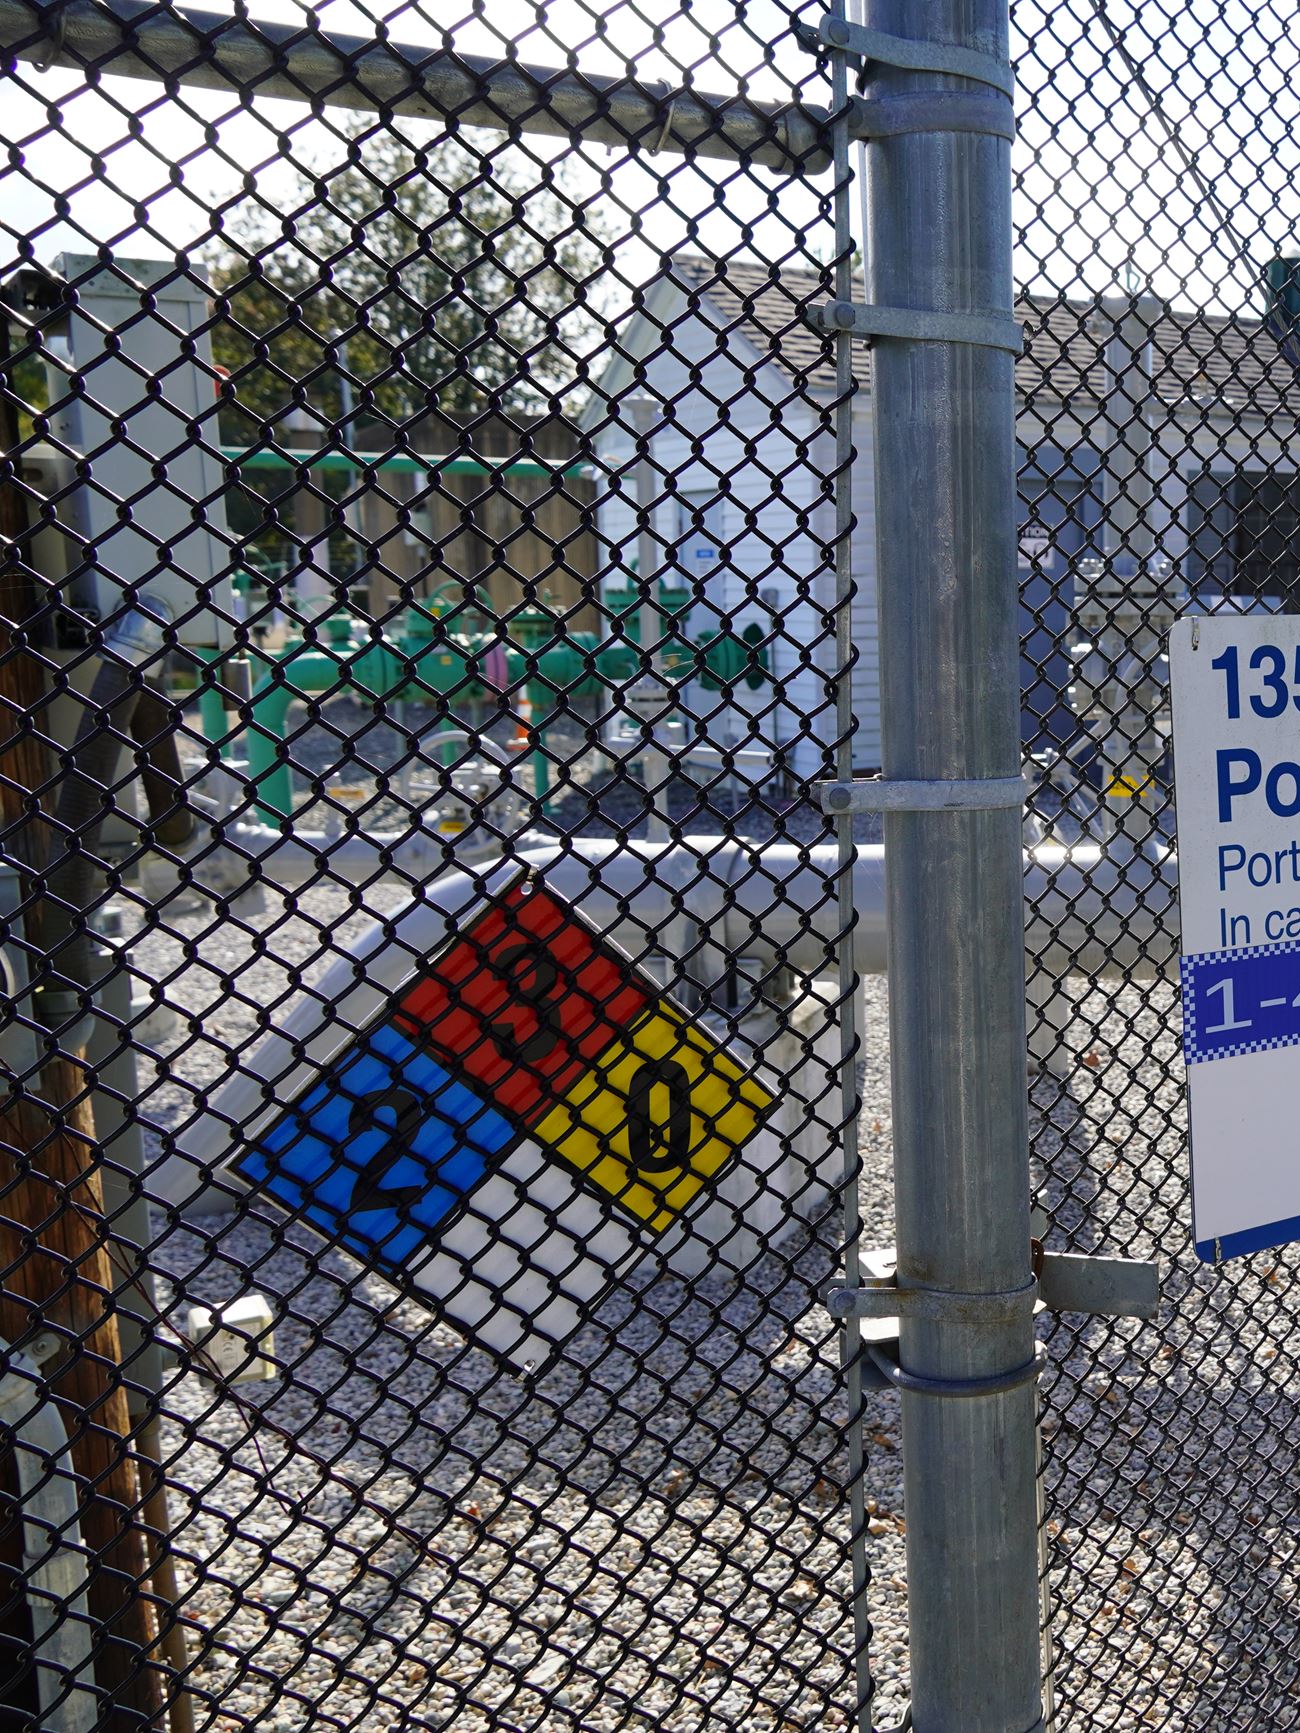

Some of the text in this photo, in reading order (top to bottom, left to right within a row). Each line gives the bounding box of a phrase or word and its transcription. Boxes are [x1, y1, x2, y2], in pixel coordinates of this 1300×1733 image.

[1220, 907, 1251, 948] In
[491, 943, 562, 1063] 3
[349, 1088, 423, 1212] 2
[627, 1058, 692, 1174] 0
